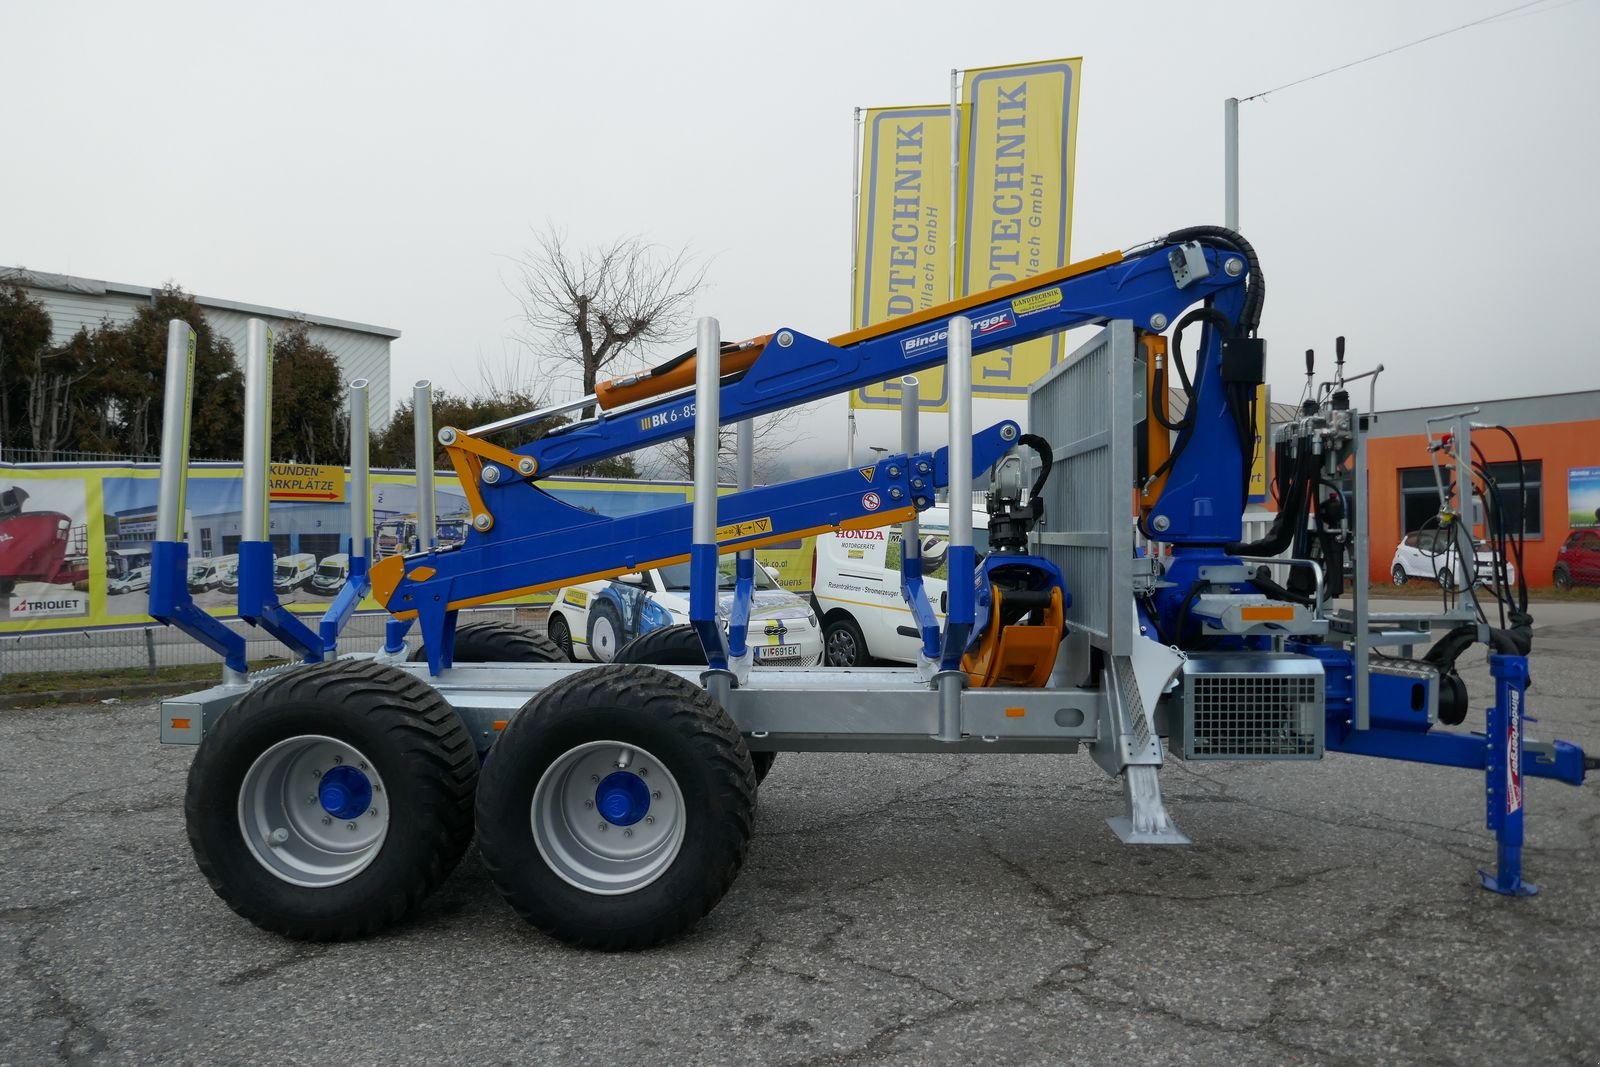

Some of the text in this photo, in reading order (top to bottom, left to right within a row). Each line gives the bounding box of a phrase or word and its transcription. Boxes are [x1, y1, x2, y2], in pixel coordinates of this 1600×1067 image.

[1028, 174, 1044, 227] GmbH
[920, 206, 938, 312] illach GmbH
[1013, 289, 1059, 306] LANDTECHNIK
[905, 313, 1007, 350] Binderger
[652, 412, 668, 427] BK
[269, 465, 325, 476] KUNDEN-
[269, 477, 334, 490] ARKPLÄTZE
[835, 530, 884, 540] HONDA
[828, 582, 862, 592] Rasentraktoren
[864, 586, 899, 597] Stromerzeuger
[27, 600, 79, 610] TRIOLIET
[1511, 690, 1519, 775] Binderberger
